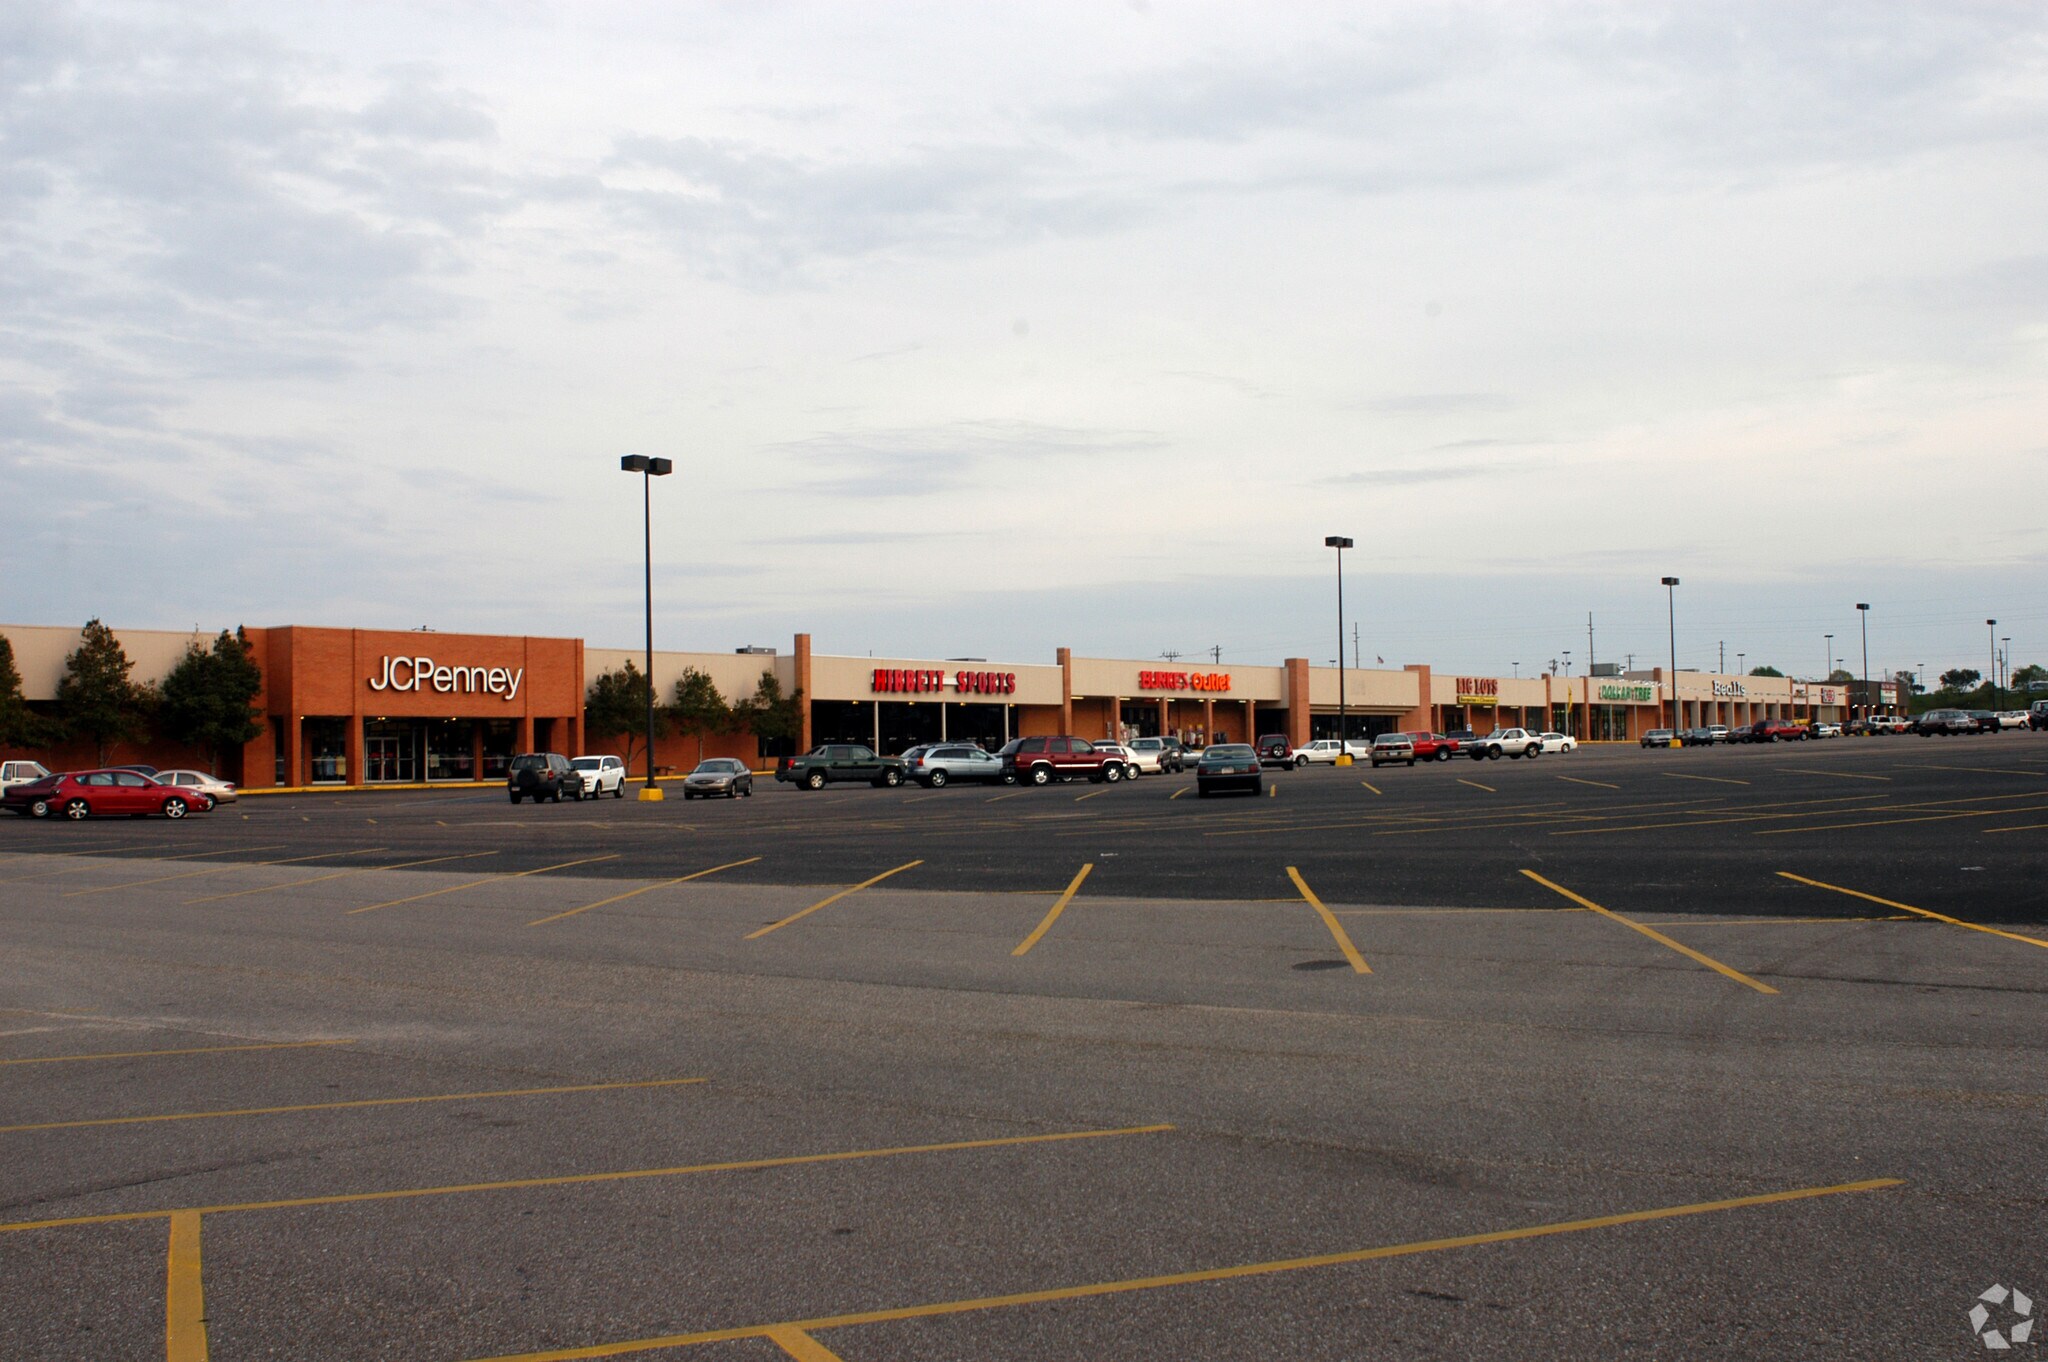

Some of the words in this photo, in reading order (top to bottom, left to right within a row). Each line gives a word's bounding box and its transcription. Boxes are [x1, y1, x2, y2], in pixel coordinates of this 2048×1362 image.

[370, 655, 523, 700] JCPenney
[874, 669, 945, 692] HIBBETT
[956, 671, 1016, 693] SPORTS
[1633, 687, 1652, 700] TREE
